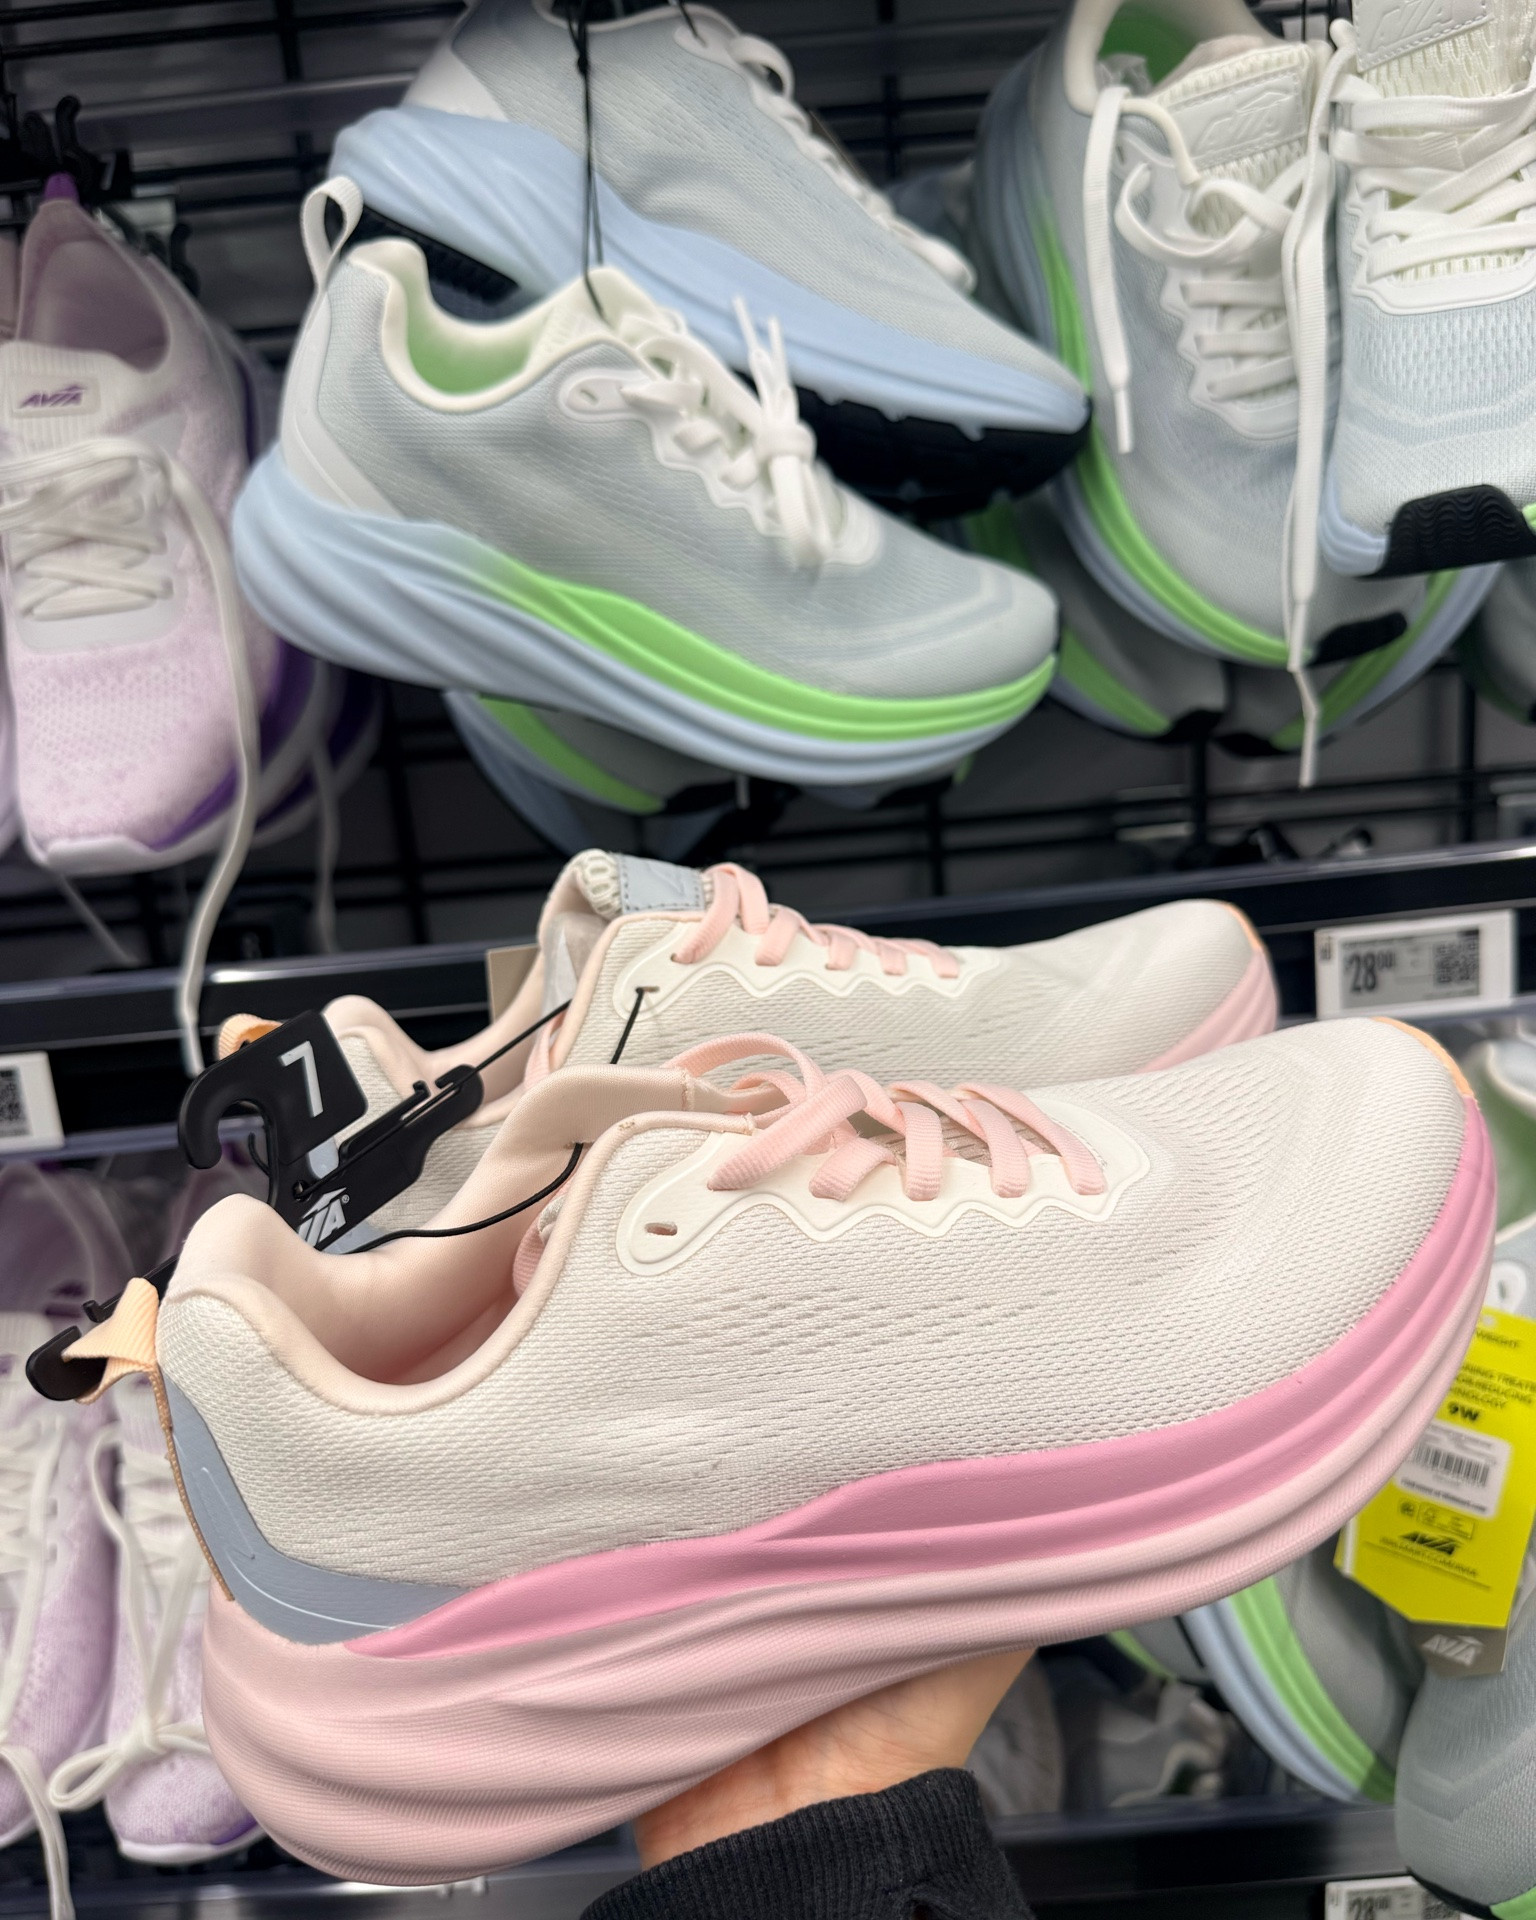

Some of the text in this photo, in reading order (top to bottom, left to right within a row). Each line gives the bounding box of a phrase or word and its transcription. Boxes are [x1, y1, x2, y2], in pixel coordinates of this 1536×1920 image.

[280, 1041, 323, 1117] 7
[1447, 1402, 1480, 1421] 9W
[1400, 1530, 1464, 1556] AVIA
[1421, 1633, 1485, 1667] AVIA
